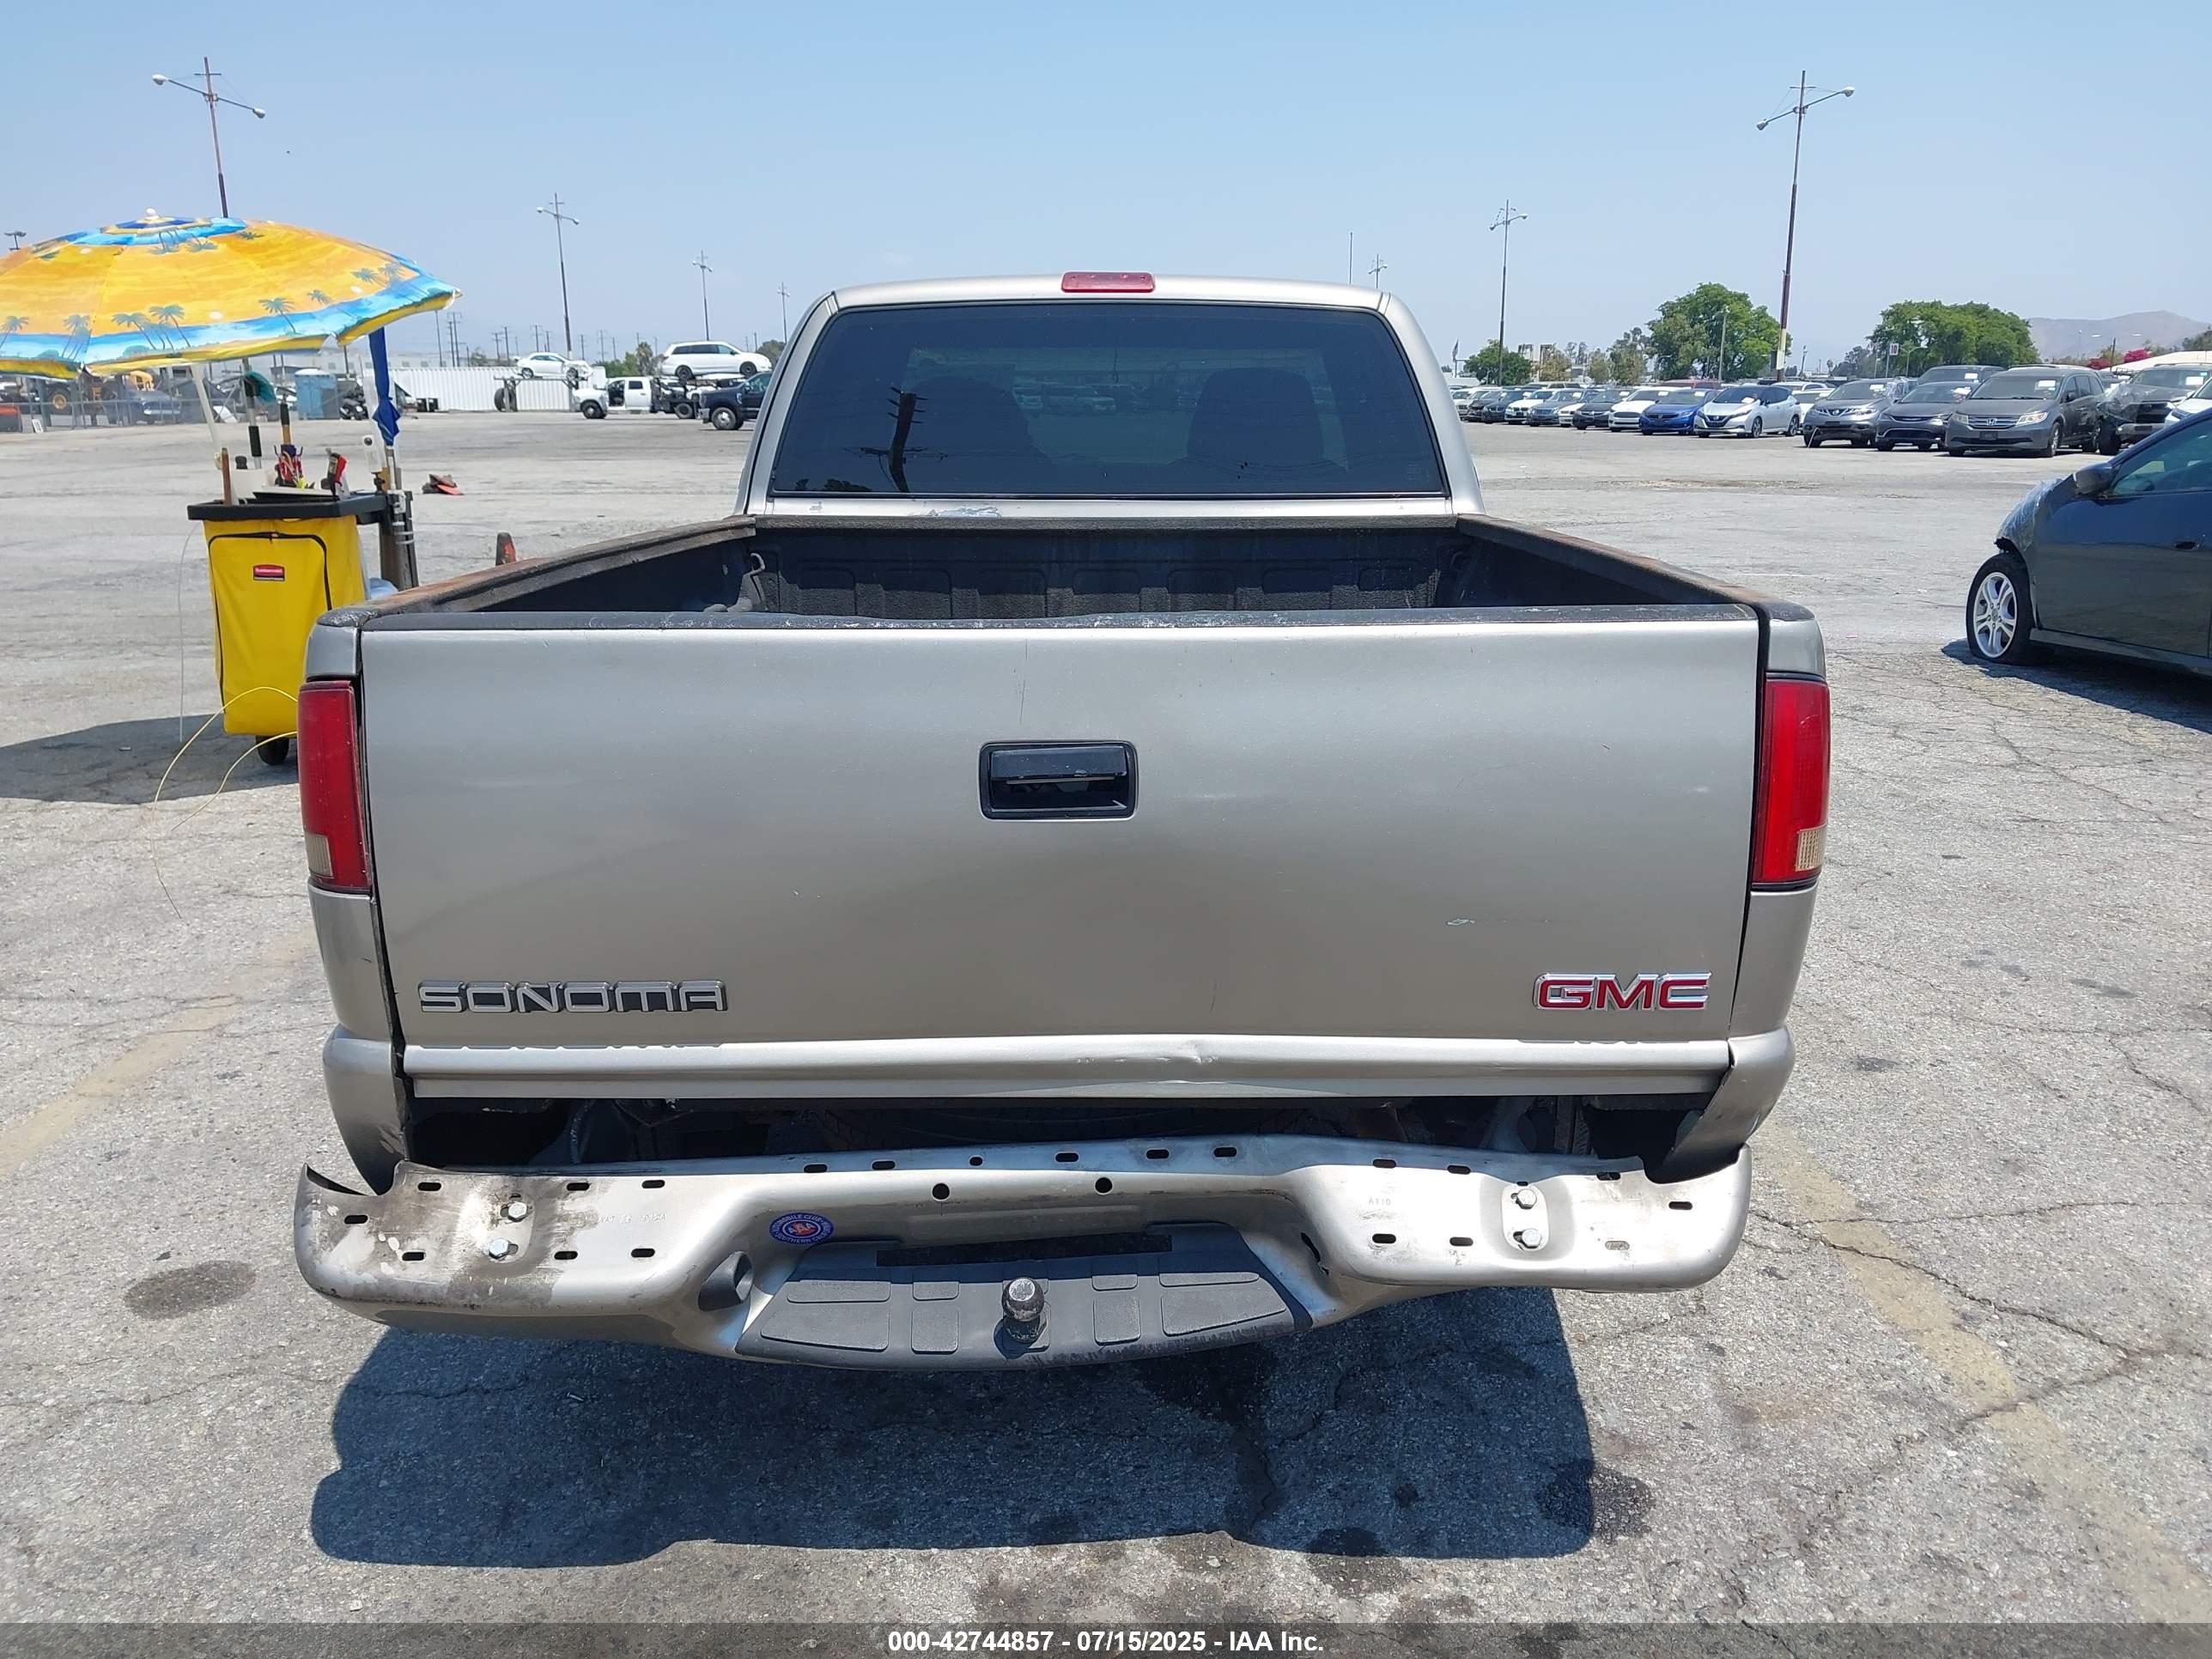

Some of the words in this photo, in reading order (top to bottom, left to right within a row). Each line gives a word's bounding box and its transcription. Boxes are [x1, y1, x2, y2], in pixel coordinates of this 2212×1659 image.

[418, 981, 728, 1013] SONOMA
[1533, 972, 1711, 1011] GMC
[787, 1221, 817, 1234] AAA
